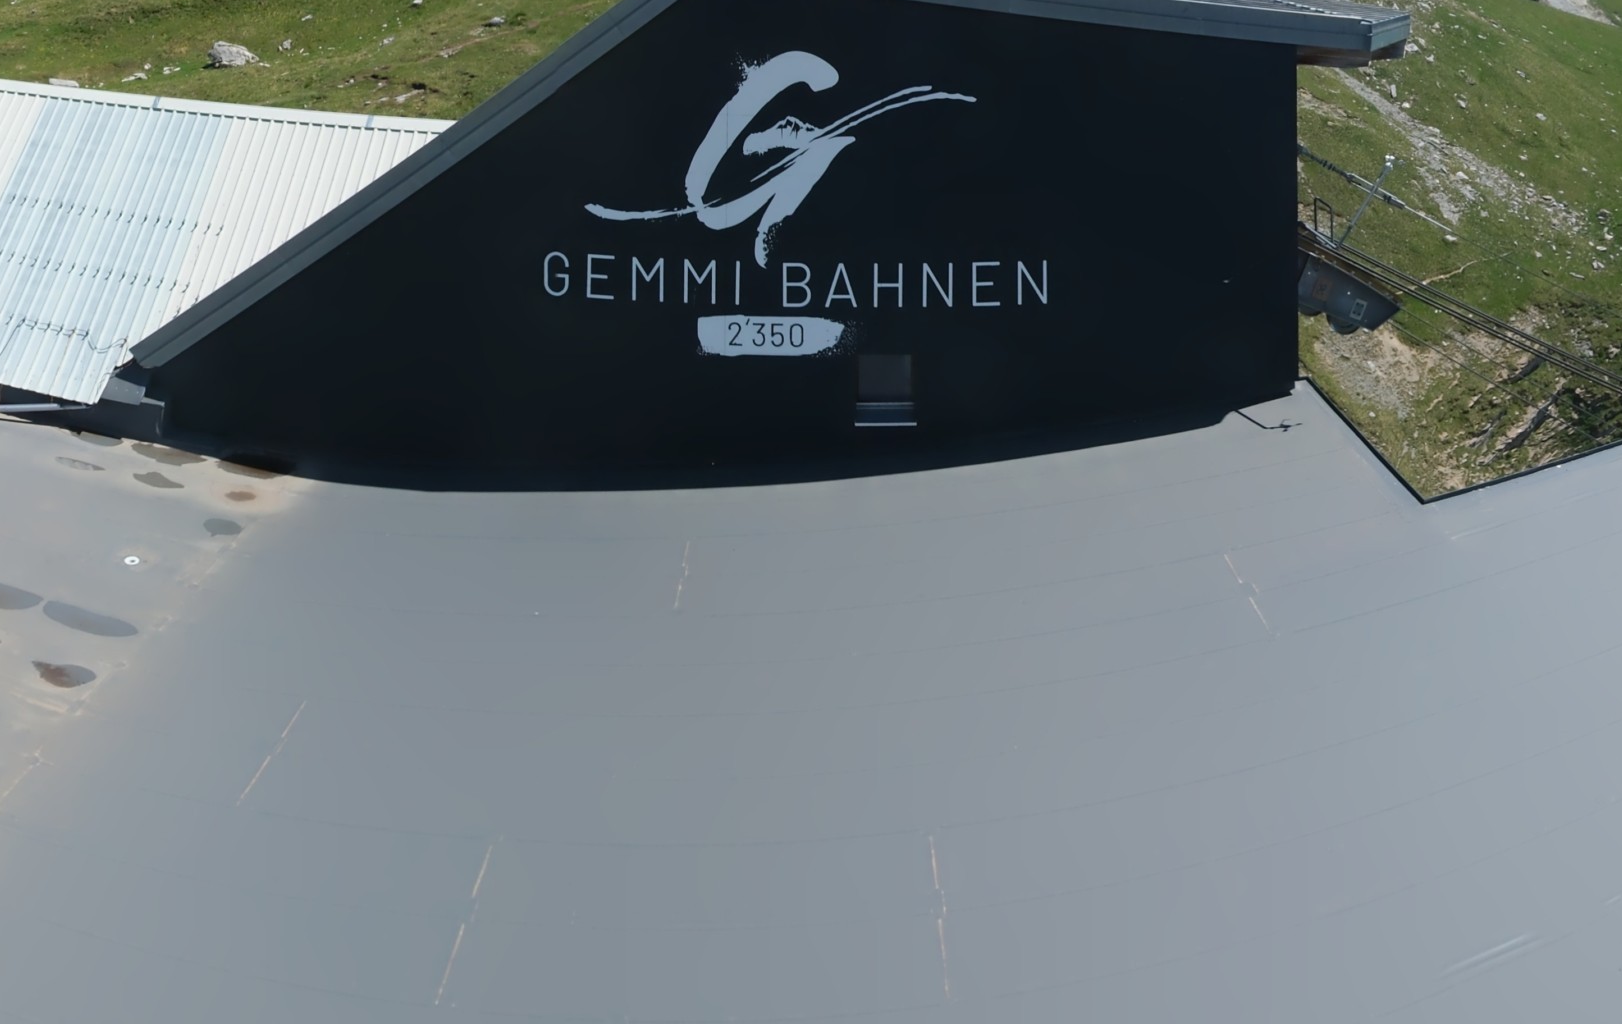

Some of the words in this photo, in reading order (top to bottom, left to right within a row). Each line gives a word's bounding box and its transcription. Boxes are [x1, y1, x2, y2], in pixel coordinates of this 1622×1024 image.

[543, 251, 741, 306] GEMMI
[782, 259, 1048, 308] BAHNEN
[727, 318, 805, 348] 2'350
